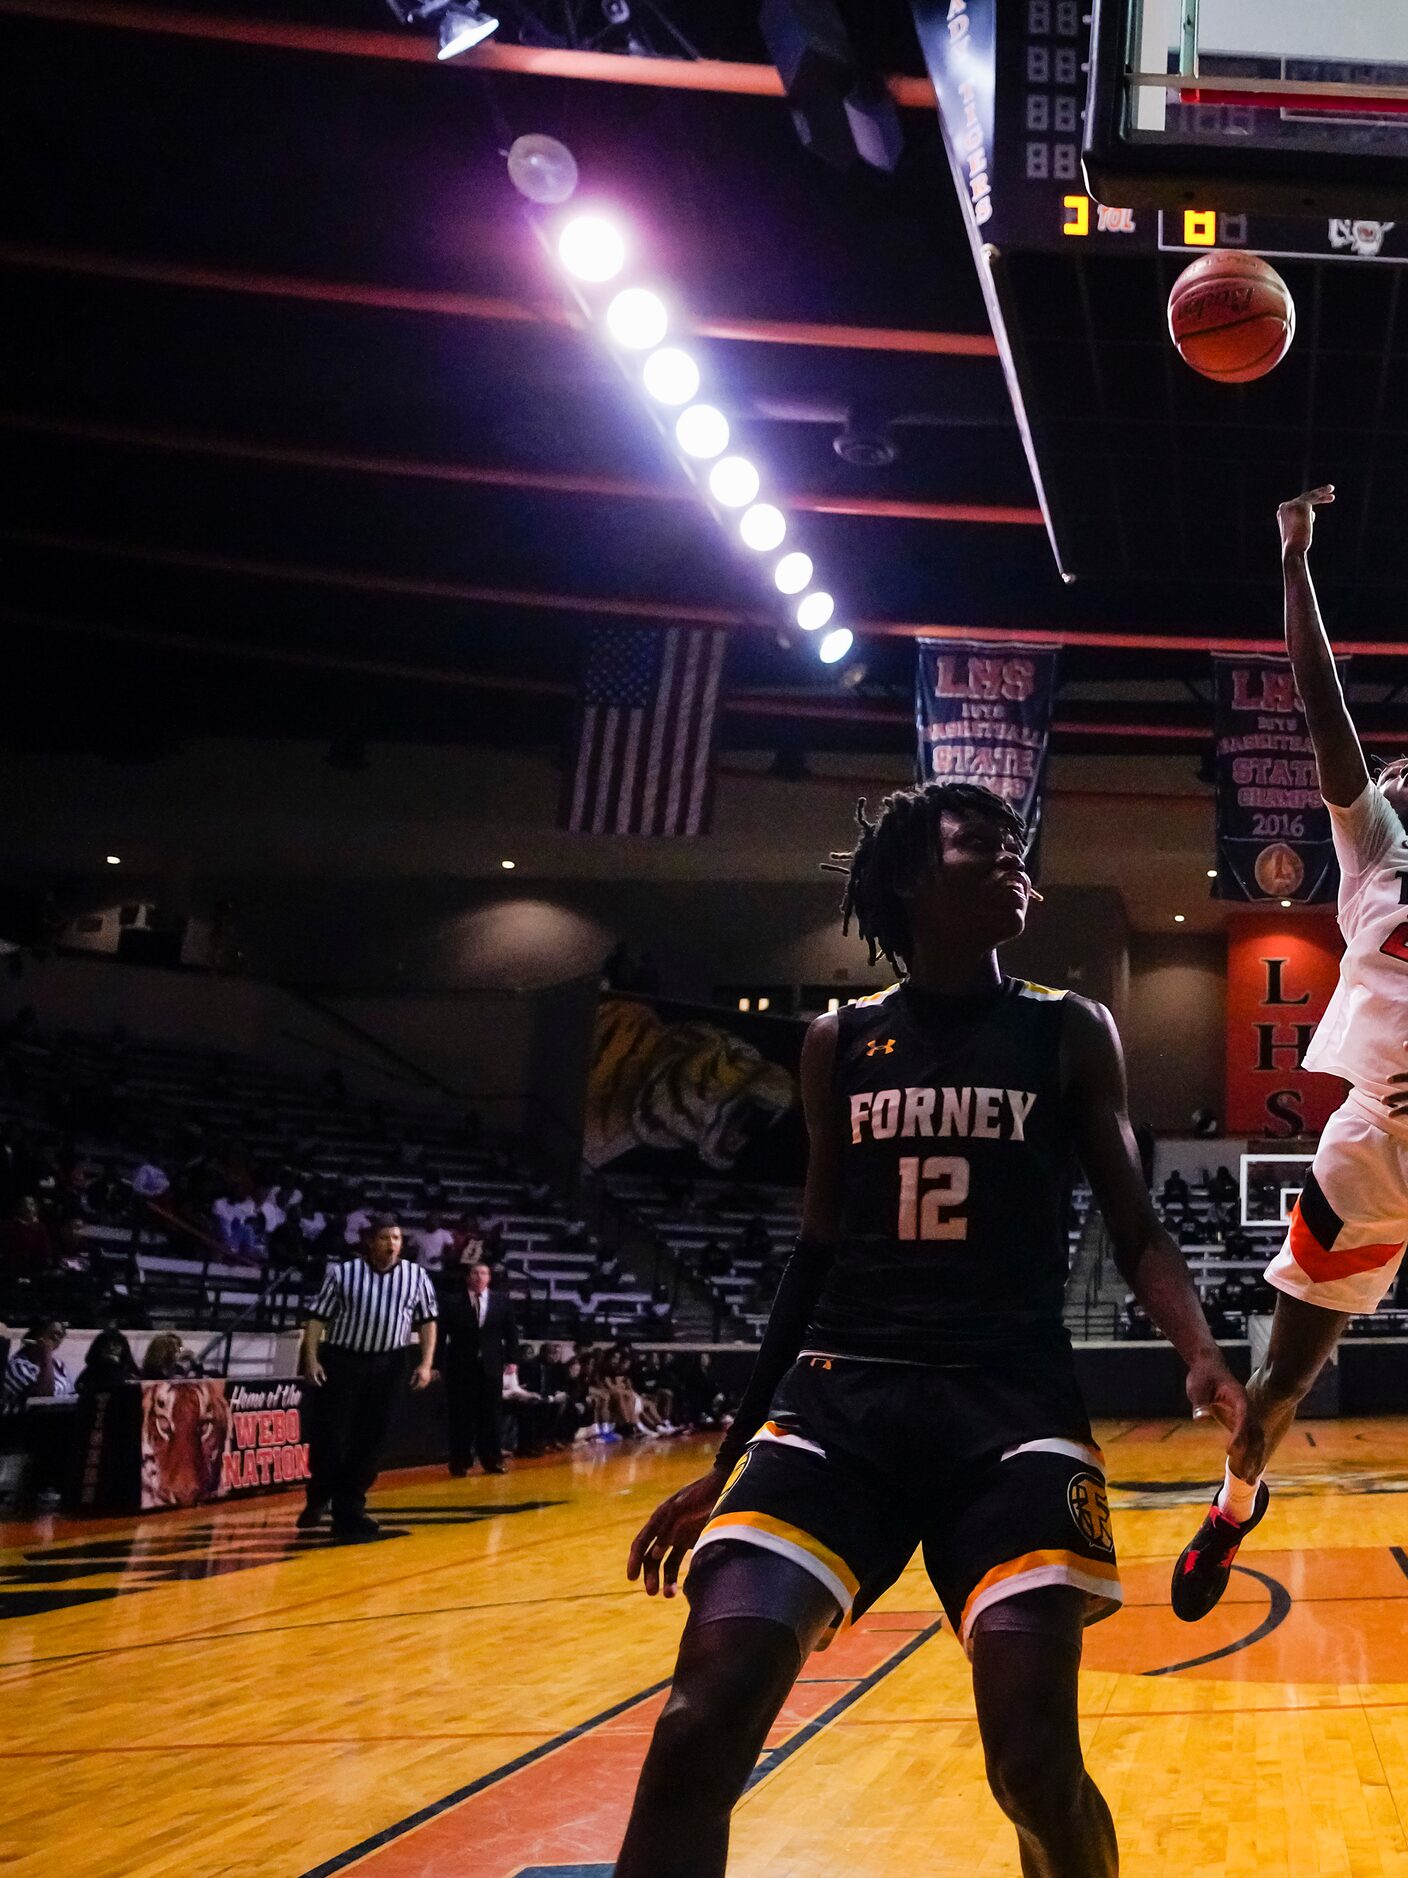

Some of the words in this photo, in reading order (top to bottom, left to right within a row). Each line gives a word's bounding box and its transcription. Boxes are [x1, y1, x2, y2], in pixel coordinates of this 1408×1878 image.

[935, 655, 1036, 701] LHS
[1232, 669, 1304, 713] LH
[932, 745, 1034, 778] STATE
[1252, 813, 1305, 838] 2016
[849, 1087, 1038, 1145] FORNEY
[897, 1155, 971, 1241] 12
[220, 1443, 312, 1490] NATION
